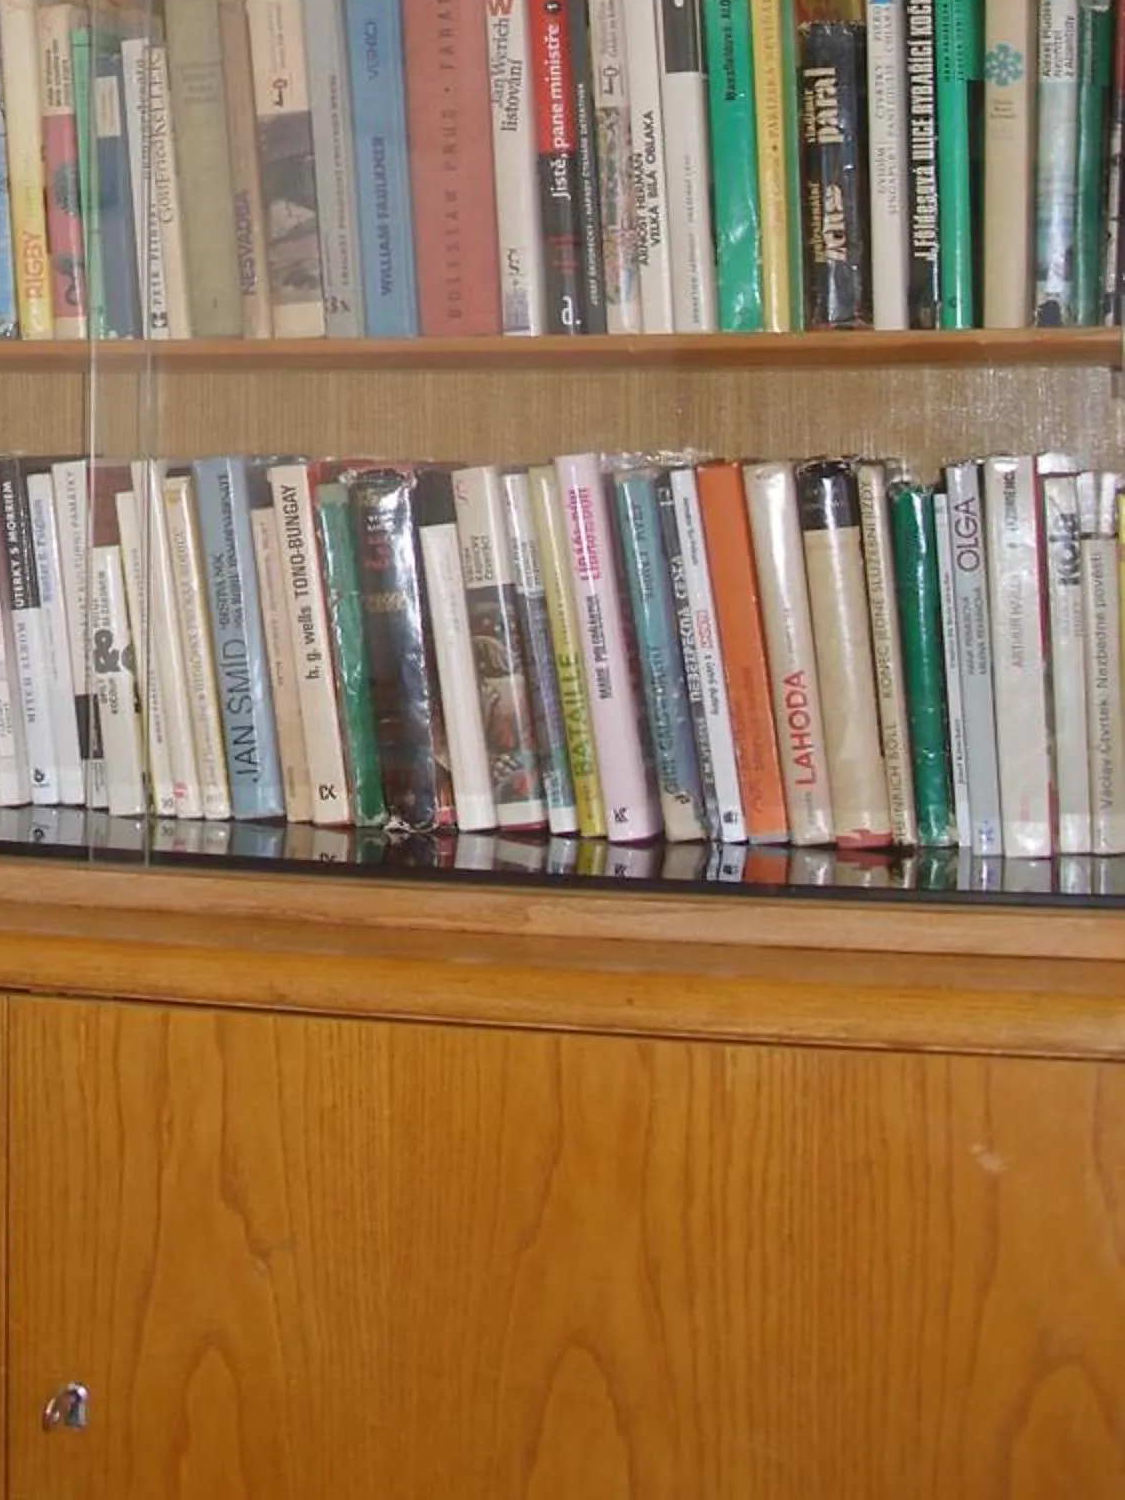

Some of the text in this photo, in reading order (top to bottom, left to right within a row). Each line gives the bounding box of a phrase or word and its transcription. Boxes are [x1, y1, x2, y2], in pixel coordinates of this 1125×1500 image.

[489, 18, 511, 80] Werich
[539, 24, 562, 99] ministře
[907, 39, 933, 115] RYBAŘÍCÍ
[501, 59, 523, 132] listování
[549, 102, 568, 149] pane
[643, 110, 657, 164] OBLAKA
[910, 118, 935, 160] ULICE
[371, 135, 393, 296] WILLIAM FAULKNER
[632, 152, 646, 210] HERMAN
[22, 230, 45, 300] RIGBY
[234, 190, 257, 296] NESVADBA
[1, 480, 18, 542] MORRIEM
[279, 483, 311, 598] TONO-BUNGAY
[954, 497, 980, 572] OLGA
[298, 605, 315, 644] wells
[306, 648, 323, 662] g.
[23, 677, 36, 724] MITCH
[221, 638, 253, 715] ŠMÍD
[876, 644, 891, 699] KONEC
[558, 653, 593, 777] BATAILLE
[782, 670, 817, 786] LAHODA
[231, 724, 258, 783] JAN
[888, 764, 905, 838] HEINRICH
